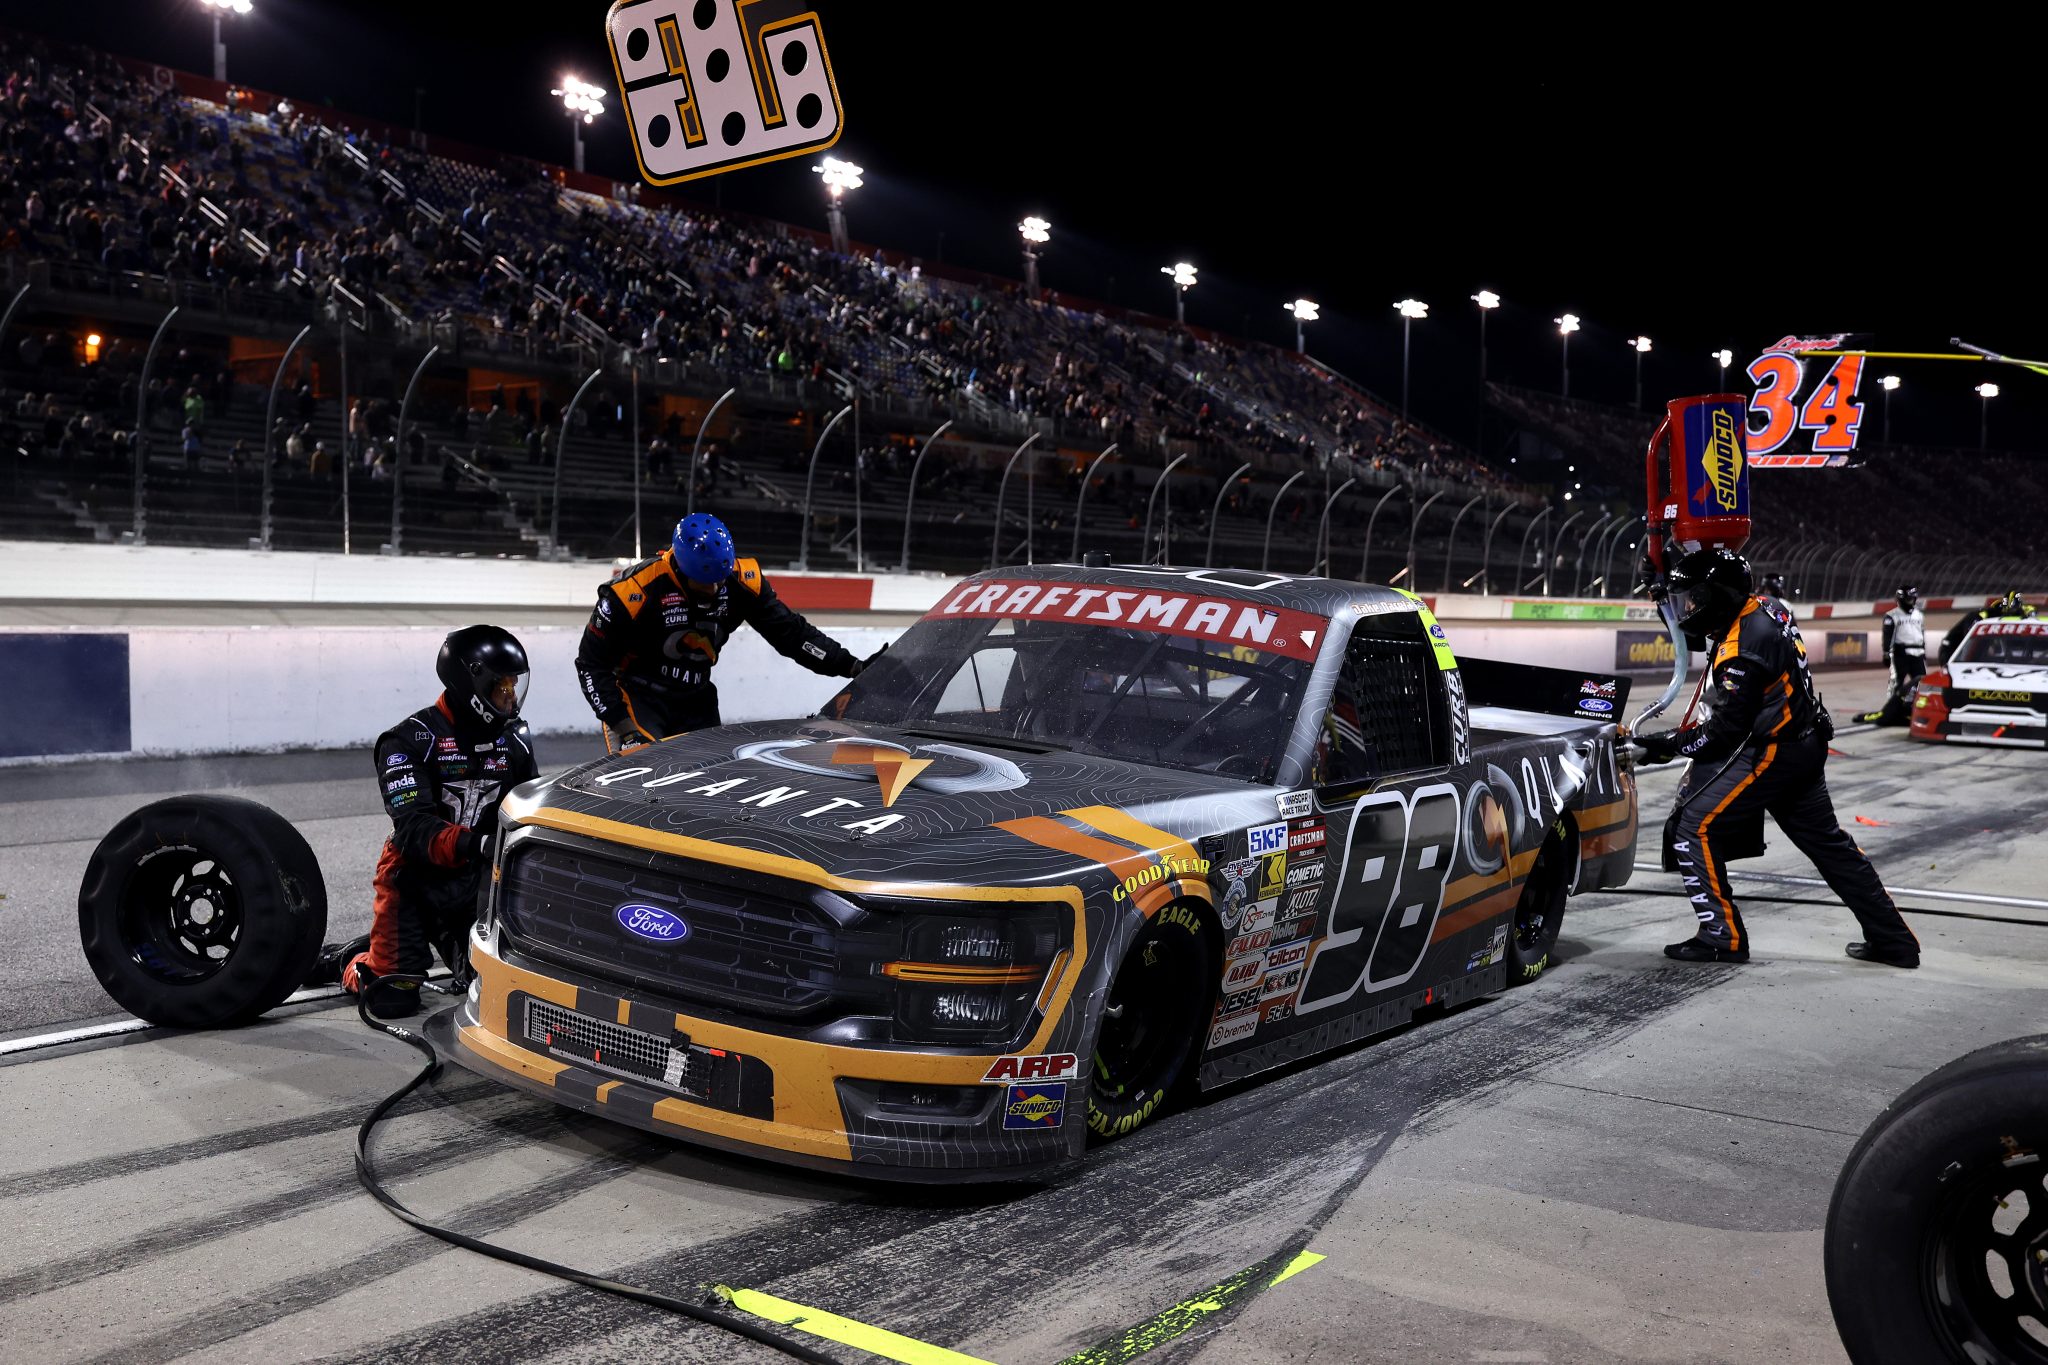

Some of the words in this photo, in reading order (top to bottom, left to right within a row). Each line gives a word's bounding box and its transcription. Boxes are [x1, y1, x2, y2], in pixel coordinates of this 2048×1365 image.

[1746, 352, 1865, 454] 34
[1714, 410, 1736, 507] SUNOCO
[665, 615, 688, 624] CURB
[943, 584, 1278, 644] CRAFTSMAN
[1629, 635, 1675, 664] GOODYEA
[1969, 689, 2032, 702] RAM
[1446, 671, 1466, 766] CURB
[1574, 710, 1612, 718] RACING
[594, 766, 906, 835] QUANTA
[1282, 807, 1294, 816] RACE
[1295, 803, 1310, 814] TRUCK
[1250, 825, 1286, 853] SKF
[1290, 830, 1324, 847] CRAFTSMAN
[1113, 853, 1210, 902] GOODYEAR
[1286, 862, 1324, 885] COMETIC
[1289, 887, 1320, 910] KLOTZ
[1294, 782, 1461, 1016] 98
[628, 908, 675, 937] Ford
[1157, 905, 1201, 936] EAGLE
[1271, 921, 1299, 941] Holley
[1228, 929, 1272, 957] CALICO
[1268, 947, 1306, 967] tilton
[1523, 953, 1547, 977] EAGLE
[1218, 986, 1262, 1015] JESEL
[1224, 1021, 1256, 1039] brembo
[984, 1055, 1077, 1078] ARP
[1010, 1101, 1061, 1115] SUNOCO
